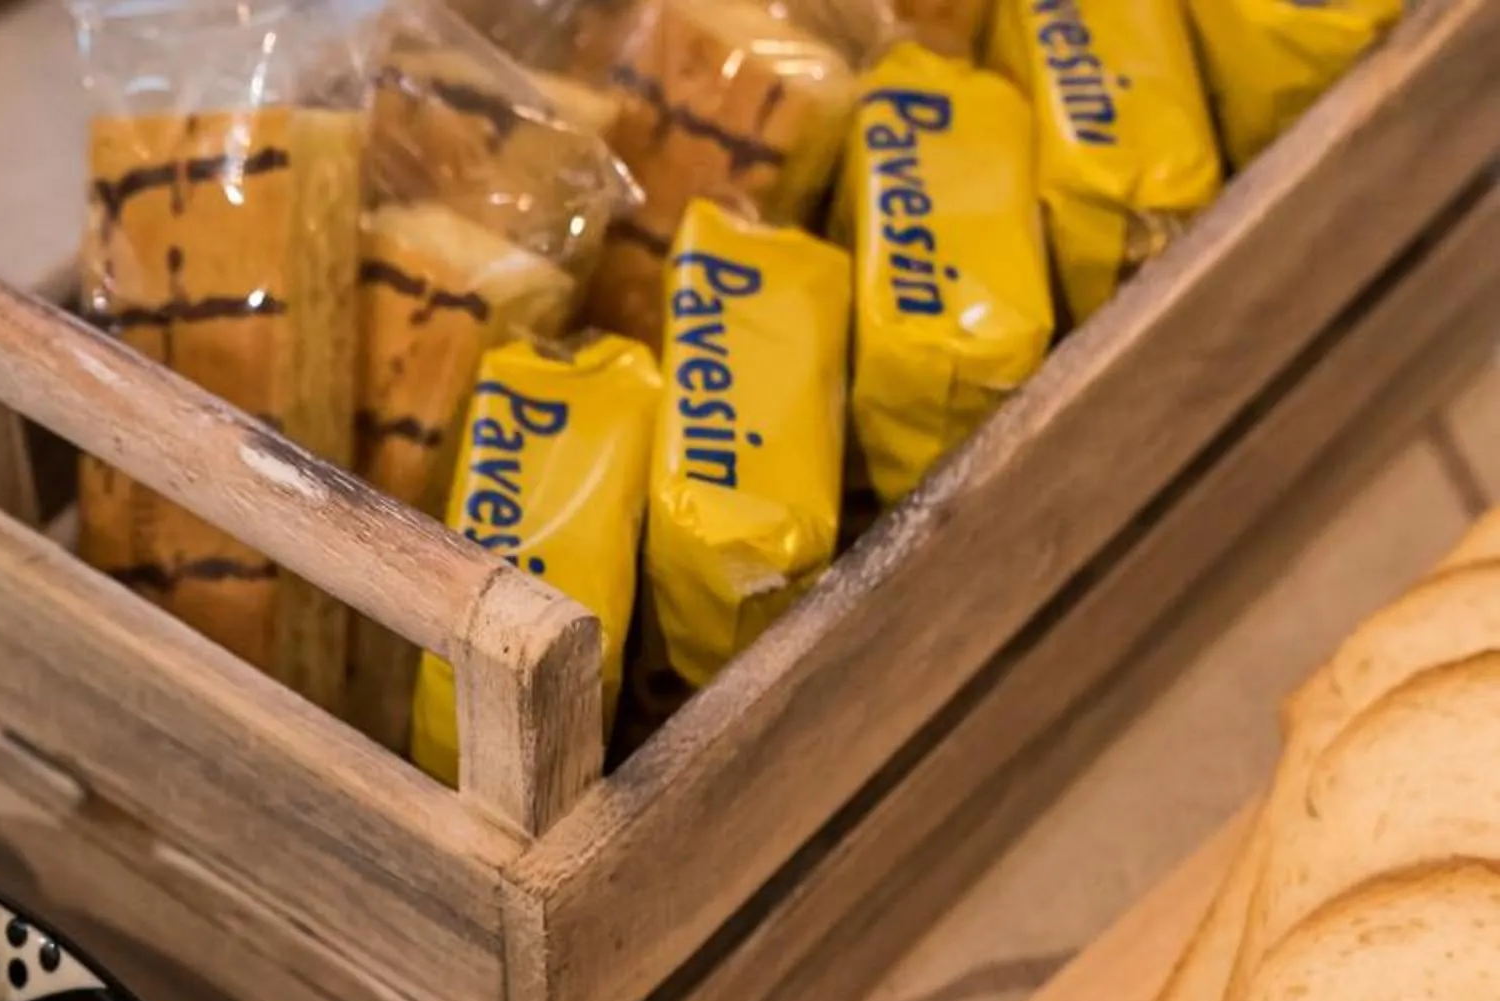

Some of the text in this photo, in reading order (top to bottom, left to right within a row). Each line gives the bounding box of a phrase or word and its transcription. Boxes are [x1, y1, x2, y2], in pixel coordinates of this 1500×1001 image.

[865, 87, 959, 317] Pavesin
[464, 378, 569, 575] Paves
[672, 249, 763, 490] Pavesin
